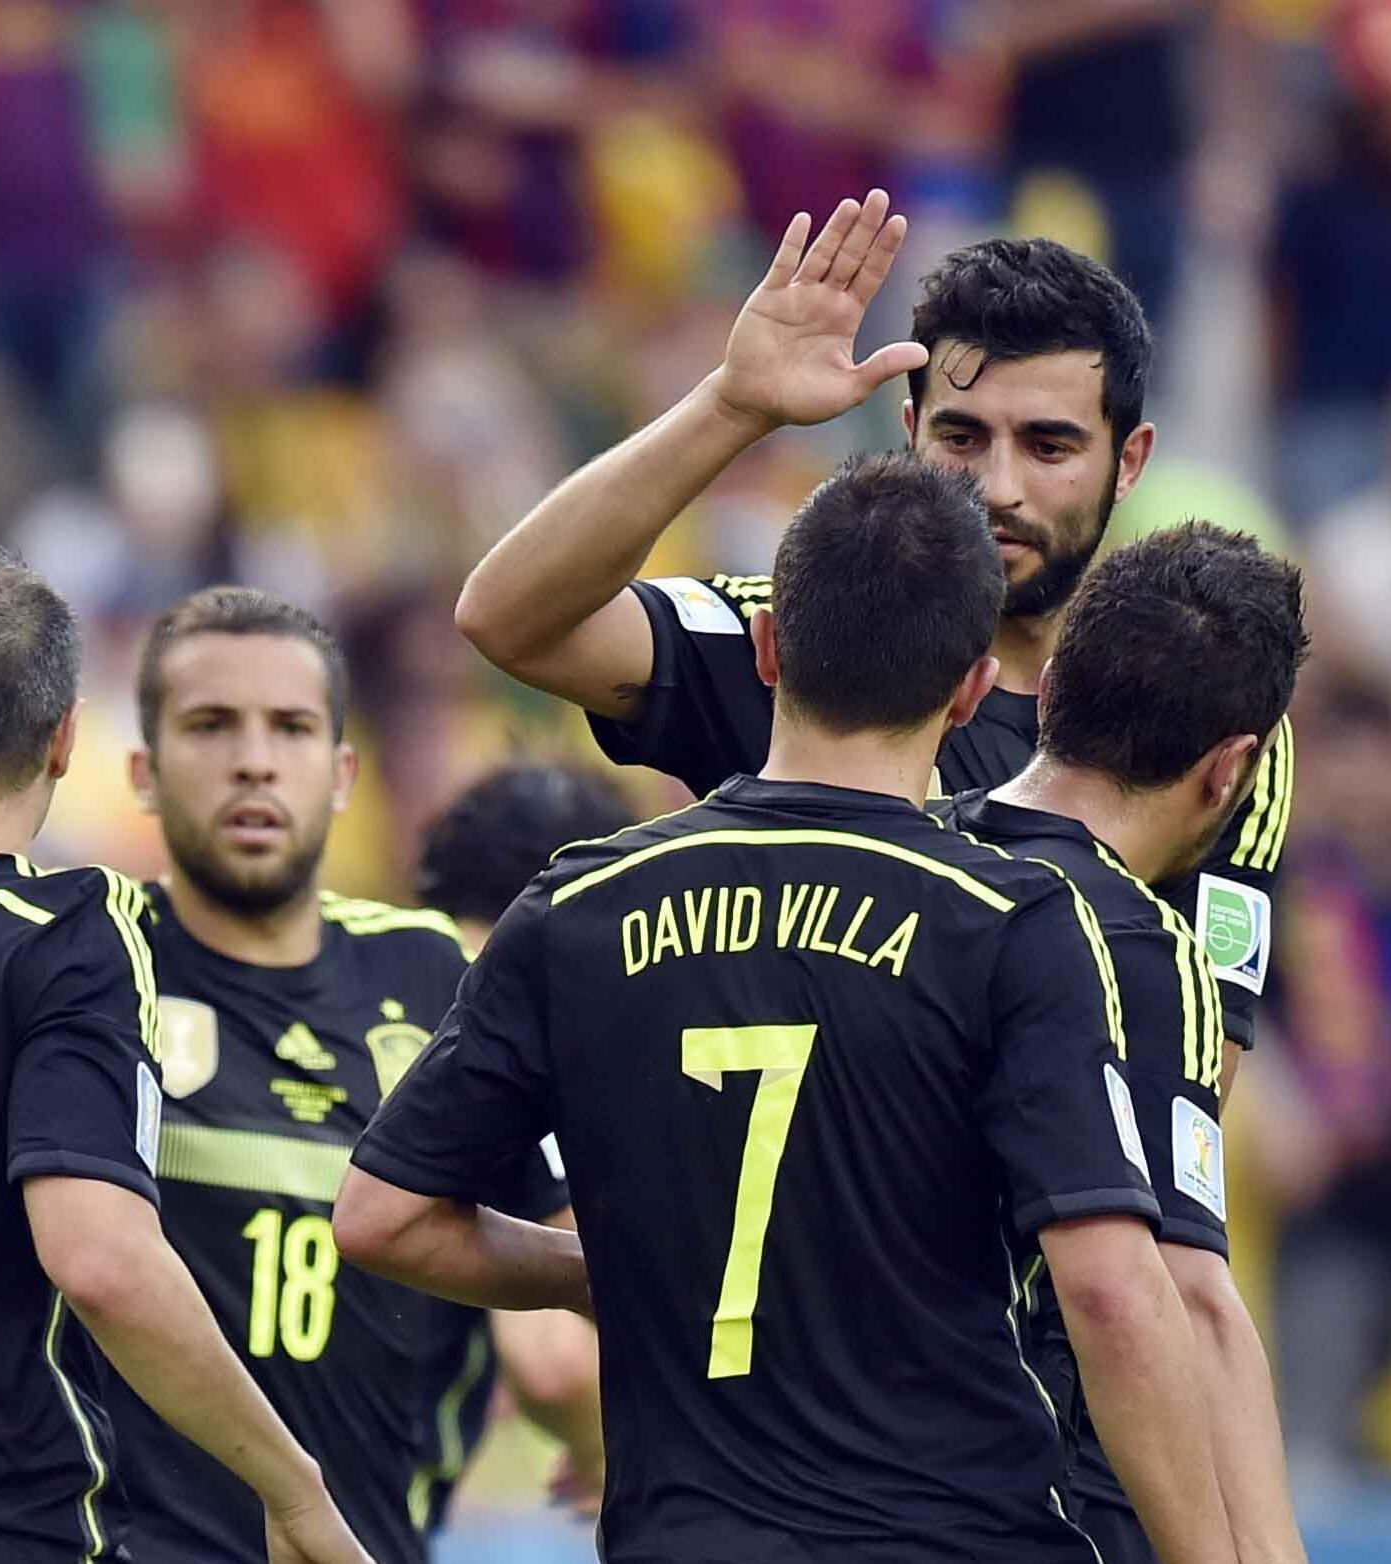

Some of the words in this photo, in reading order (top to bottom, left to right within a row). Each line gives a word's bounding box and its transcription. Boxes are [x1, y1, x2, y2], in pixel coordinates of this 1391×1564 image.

[622, 886, 762, 976] DAVID
[776, 884, 920, 977] VILLA
[682, 1023, 818, 1379] 7
[242, 1208, 340, 1362] 18
